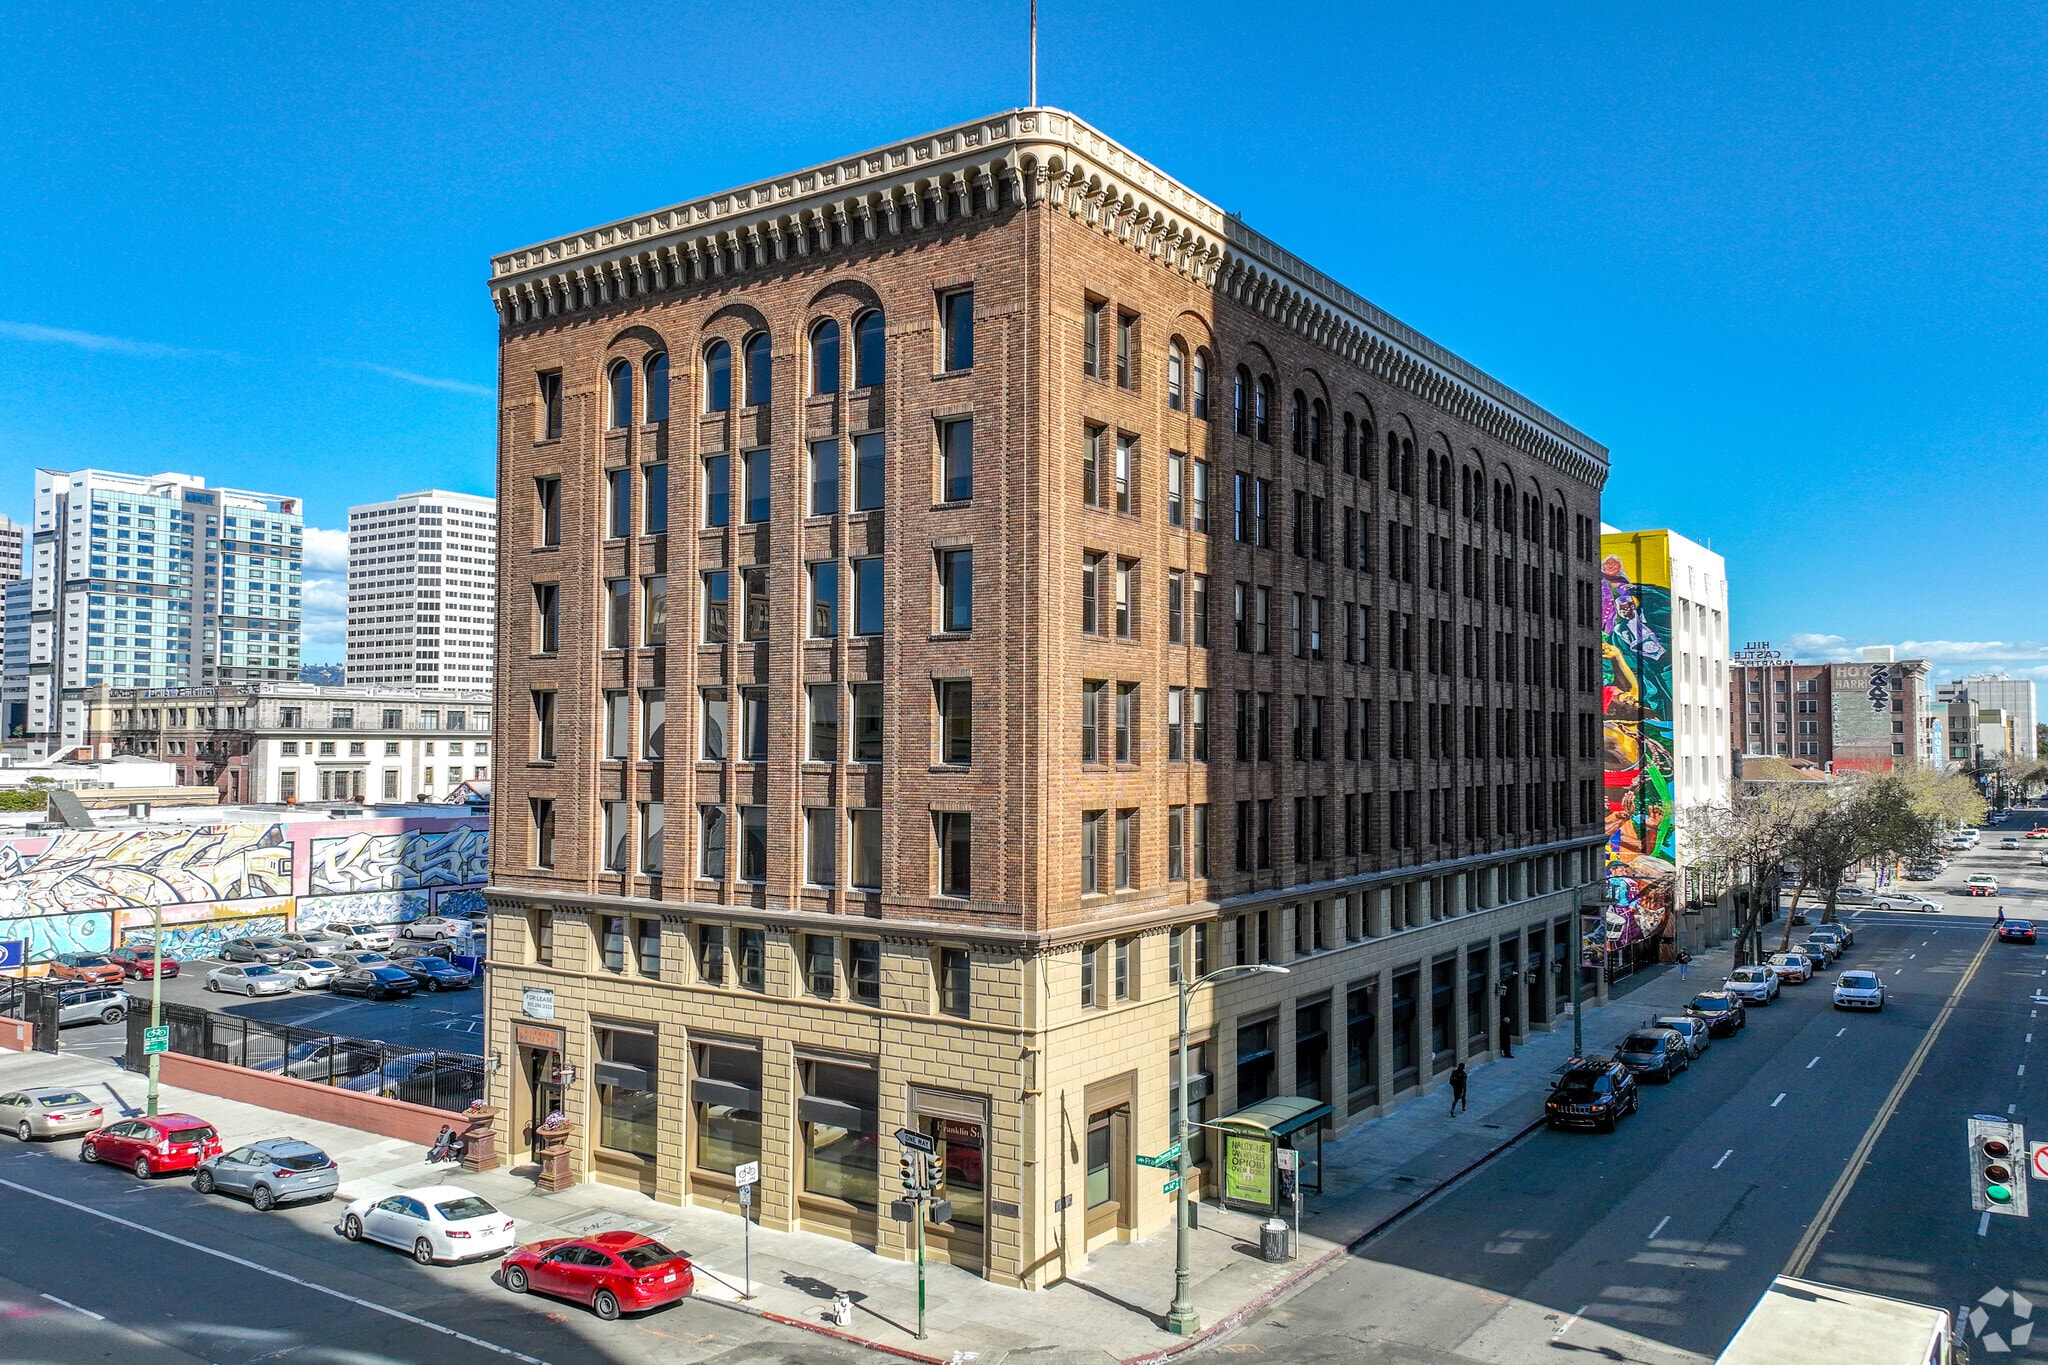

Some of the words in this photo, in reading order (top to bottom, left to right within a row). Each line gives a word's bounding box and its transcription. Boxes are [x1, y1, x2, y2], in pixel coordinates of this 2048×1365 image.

[937, 1120, 969, 1137] Franklin
[905, 1134, 916, 1144] ONE
[917, 1138, 929, 1148] WAY
[1231, 1156, 1266, 1170] OPIOID
